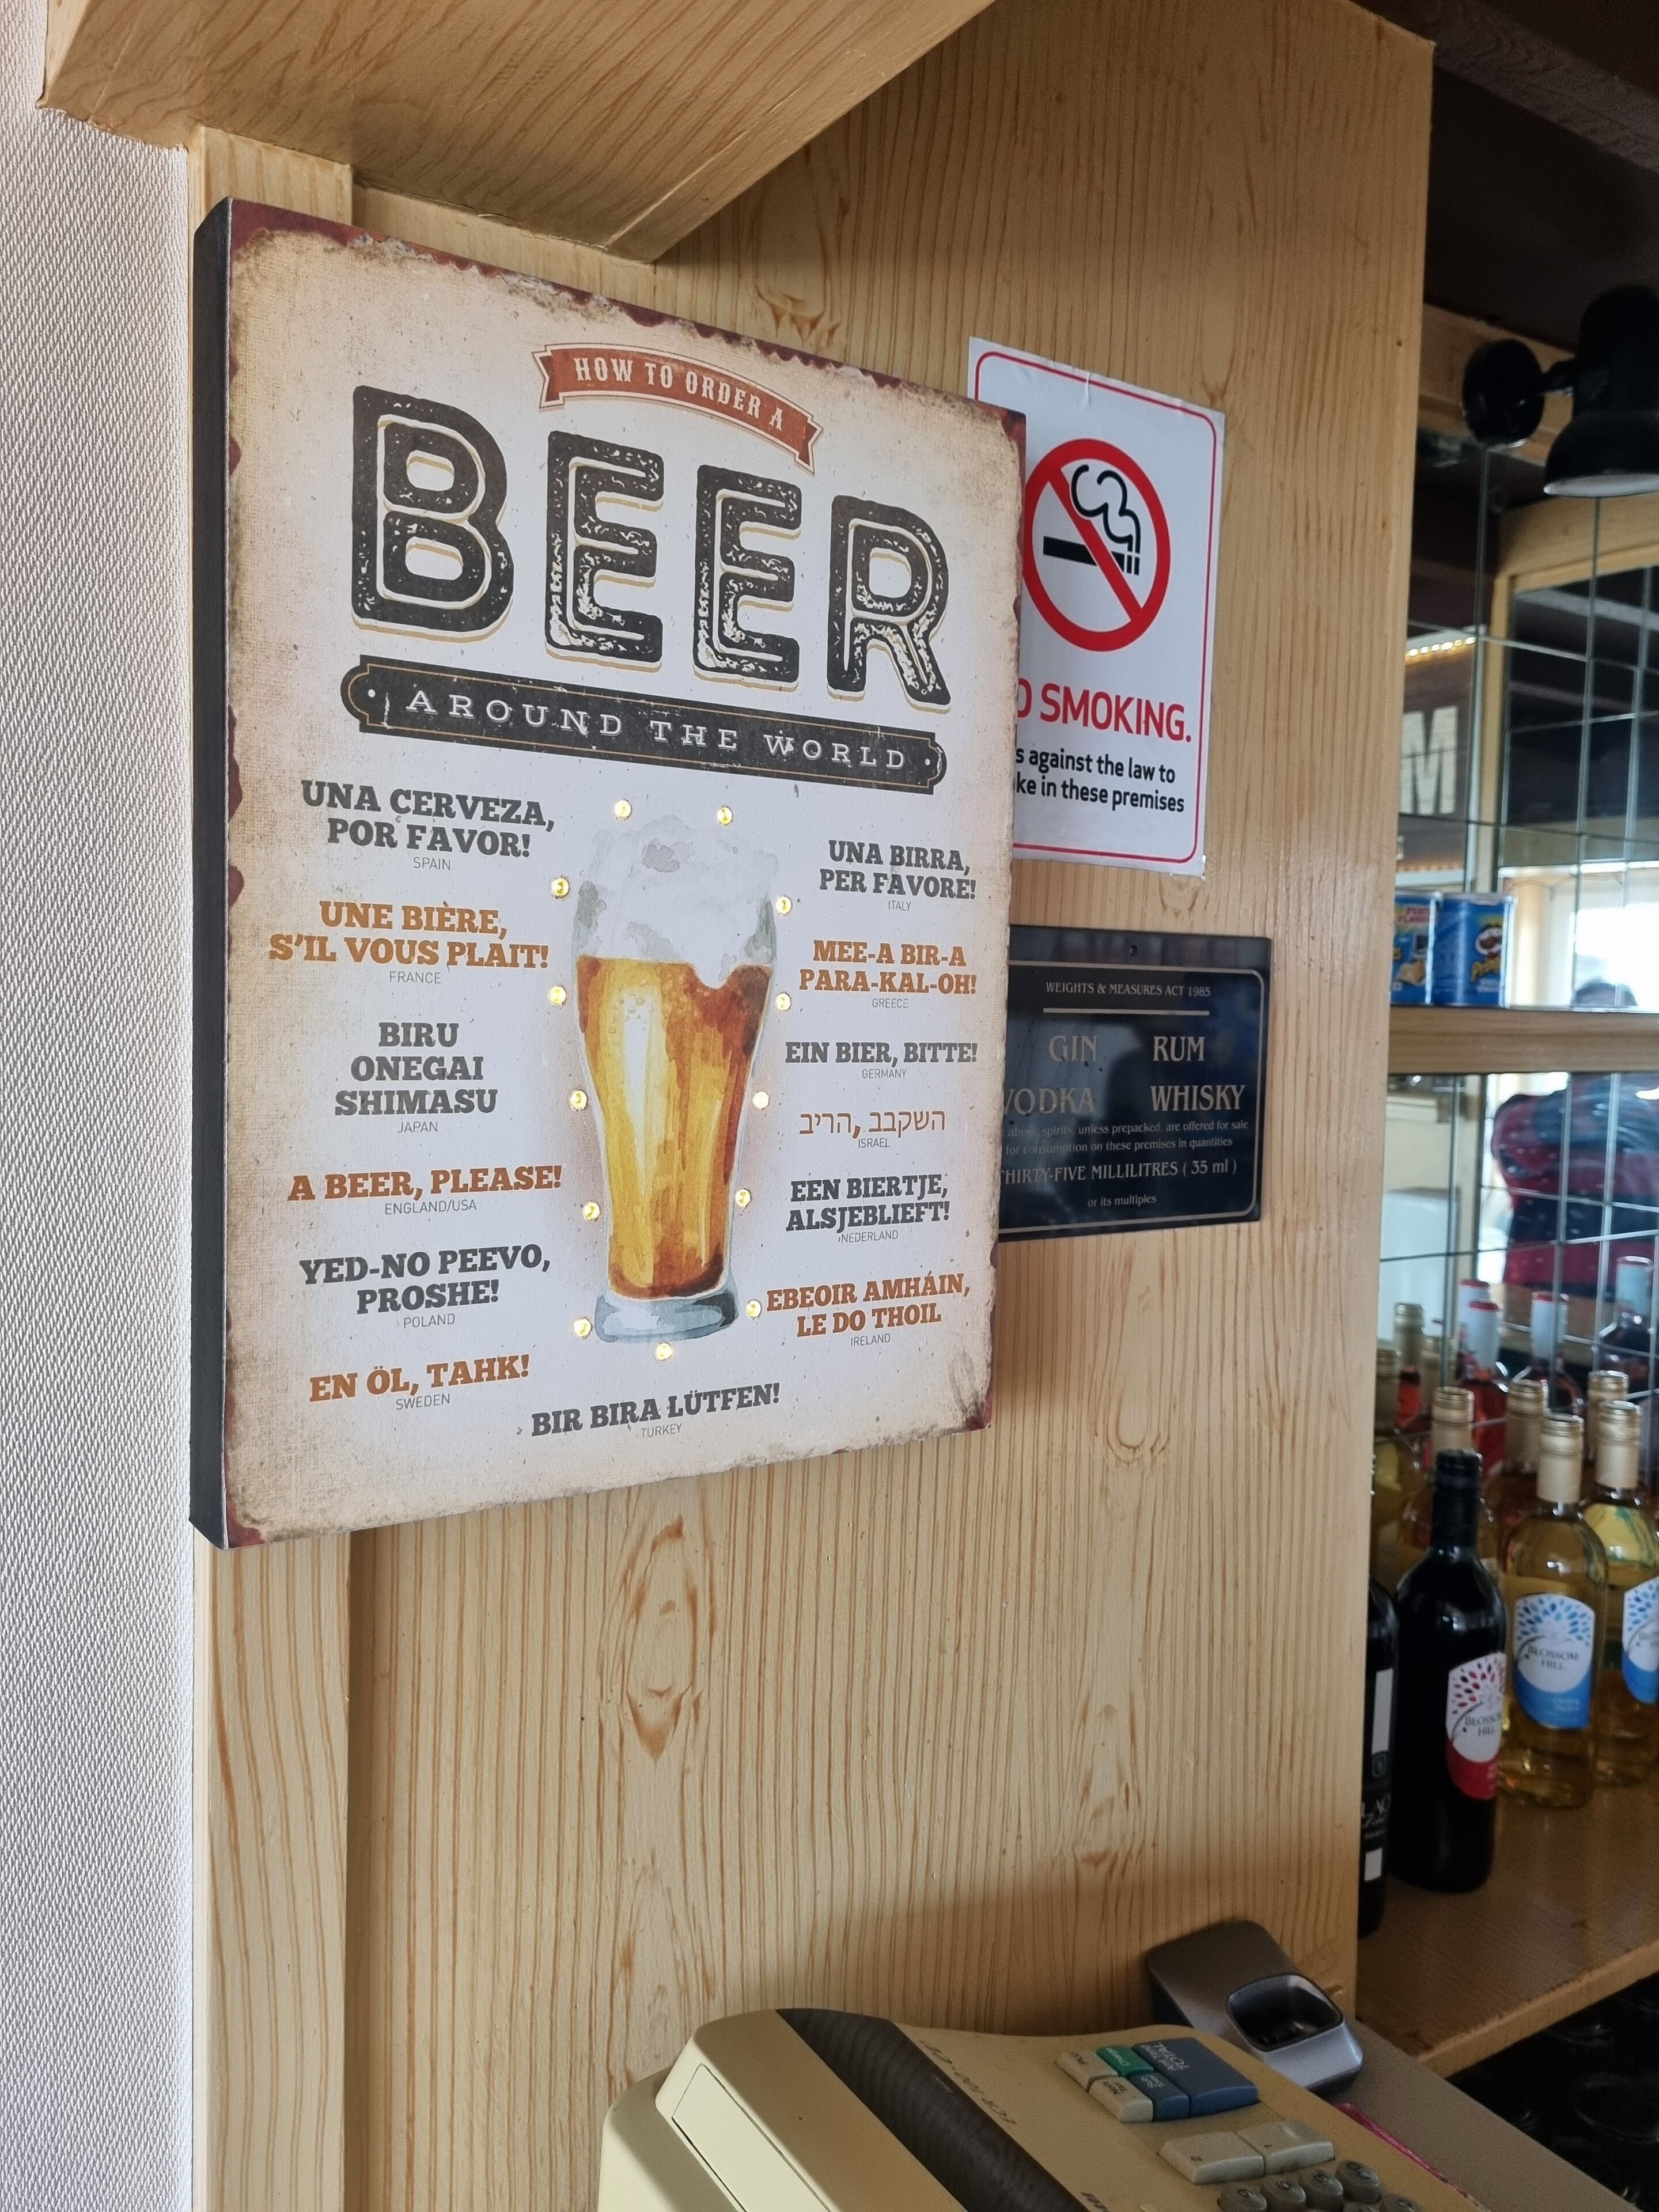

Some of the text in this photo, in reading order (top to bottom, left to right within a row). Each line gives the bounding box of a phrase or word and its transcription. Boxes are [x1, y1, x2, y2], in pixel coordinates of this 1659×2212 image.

[574, 357, 783, 431] HOW TO ORDER A
[352, 385, 950, 710] BEER
[1017, 677, 1191, 743] O SMOKING.
[405, 690, 906, 771] AROUND THE WORLD
[1029, 747, 1092, 774] against
[1097, 754, 1124, 777] the
[1128, 757, 1156, 781] law
[1159, 764, 1176, 784] to
[301, 779, 555, 832] UNA CERVEZA,
[1014, 771, 1185, 813] ke in these premises
[328, 817, 531, 857] POR FAVOR!
[413, 856, 452, 870] SPAIN
[829, 839, 970, 876] UNA BIRRA,
[820, 868, 976, 900] PER FAVORE!
[888, 900, 911, 912] ITALY
[319, 900, 507, 940] UNE BIÈRE,
[344, 937, 439, 965] VOUS
[813, 940, 966, 967] MEE-A BIR-A
[389, 971, 441, 984] FRANCE
[799, 969, 977, 994] PARA-KAL-OH!
[1046, 982, 1210, 997] WEIGHTS & MEASURES ACT 1985
[872, 997, 909, 1009] GREECE
[378, 1022, 459, 1047] BIRU
[785, 1041, 978, 1067] EIN BIER, BITTE!
[1049, 1035, 1206, 1062] GIN RUM
[350, 1056, 484, 1081] ONEGAI
[862, 1069, 907, 1079] GERMANY
[335, 1089, 498, 1116] SHIMASU
[1151, 1084, 1245, 1112] WHISKY
[397, 1121, 438, 1133] JAPAN
[1078, 1124, 1109, 1134] unless
[1166, 1123, 1180, 1132] are
[1183, 1120, 1214, 1131] offered
[1217, 1120, 1228, 1130] for
[1231, 1119, 1248, 1130] sale
[858, 1138, 890, 1148] ISRAEL
[1006, 1144, 1019, 1156] for
[1091, 1143, 1103, 1152] on
[1106, 1141, 1131, 1150] these
[1134, 1138, 1176, 1152] premises
[1179, 1139, 1187, 1148] in
[1189, 1137, 1233, 1150] quantities
[288, 1165, 562, 1201] A BEER, PLEASE!
[1092, 1162, 1178, 1179] MILLILITRES
[791, 1174, 948, 1202] EEN BIERTJE,
[1088, 1194, 1157, 1207] or its multiples
[385, 1199, 477, 1214] ENGLAND/USA
[786, 1201, 950, 1233] ALSJEBLIEFT!
[841, 1229, 899, 1243] NEDERLAND
[299, 1244, 550, 1285] YED-NO PEEVO,
[357, 1279, 499, 1315] PROSHE!
[767, 1271, 970, 1312] EBEOIR AMHÁIN,
[403, 1313, 455, 1328] POLAND
[797, 1303, 941, 1337] LE DO THOIL
[851, 1334, 891, 1347] IRELAND
[309, 1354, 529, 1402] EN ÖL, TAHK!
[396, 1393, 450, 1410] SWEDEN
[532, 1382, 780, 1437] BIR BIRA LÜTFEN!
[641, 1423, 683, 1438] TURKEY
